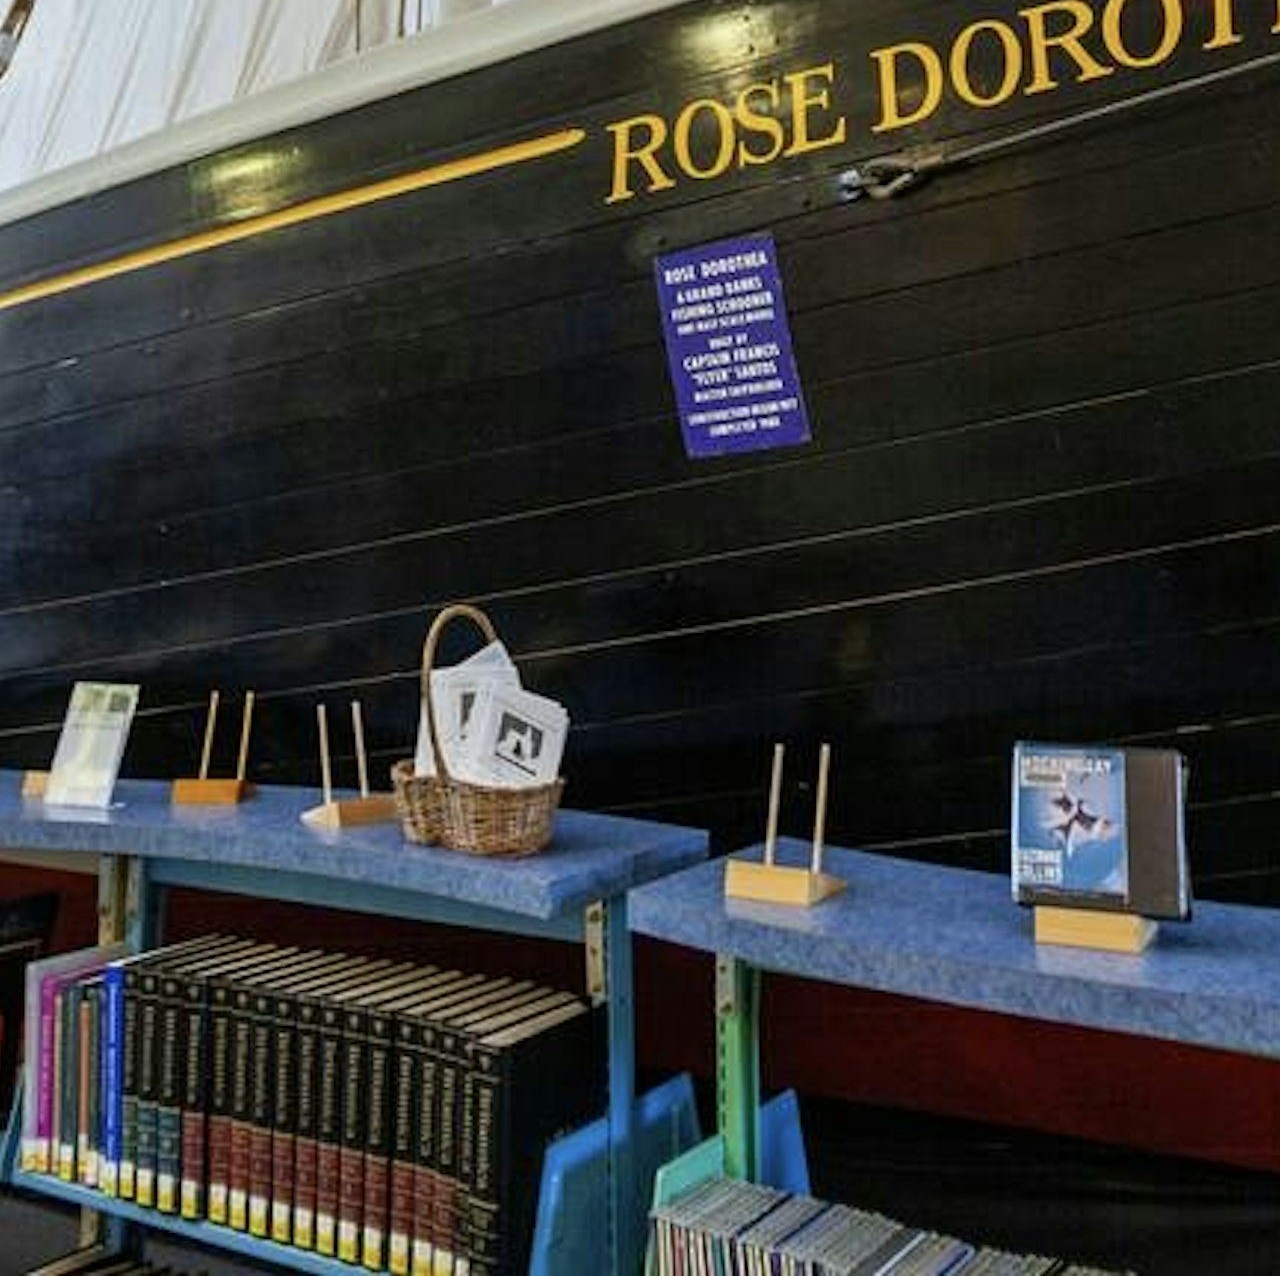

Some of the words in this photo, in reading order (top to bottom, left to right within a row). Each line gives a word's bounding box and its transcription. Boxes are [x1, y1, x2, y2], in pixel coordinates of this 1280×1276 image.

[605, 63, 847, 205] ROSE
[664, 264, 696, 285] ROSE
[700, 250, 768, 277] DOROTHEA
[676, 289, 686, 304] A
[686, 283, 723, 303] GRAND
[725, 275, 763, 296] BANKS
[671, 302, 715, 322] FISHING
[716, 290, 774, 315] SCHOONER
[736, 332, 749, 346] BY
[682, 349, 731, 372] CAPTAIN
[733, 341, 781, 363] FRANCIS
[733, 360, 778, 381] SANTOS
